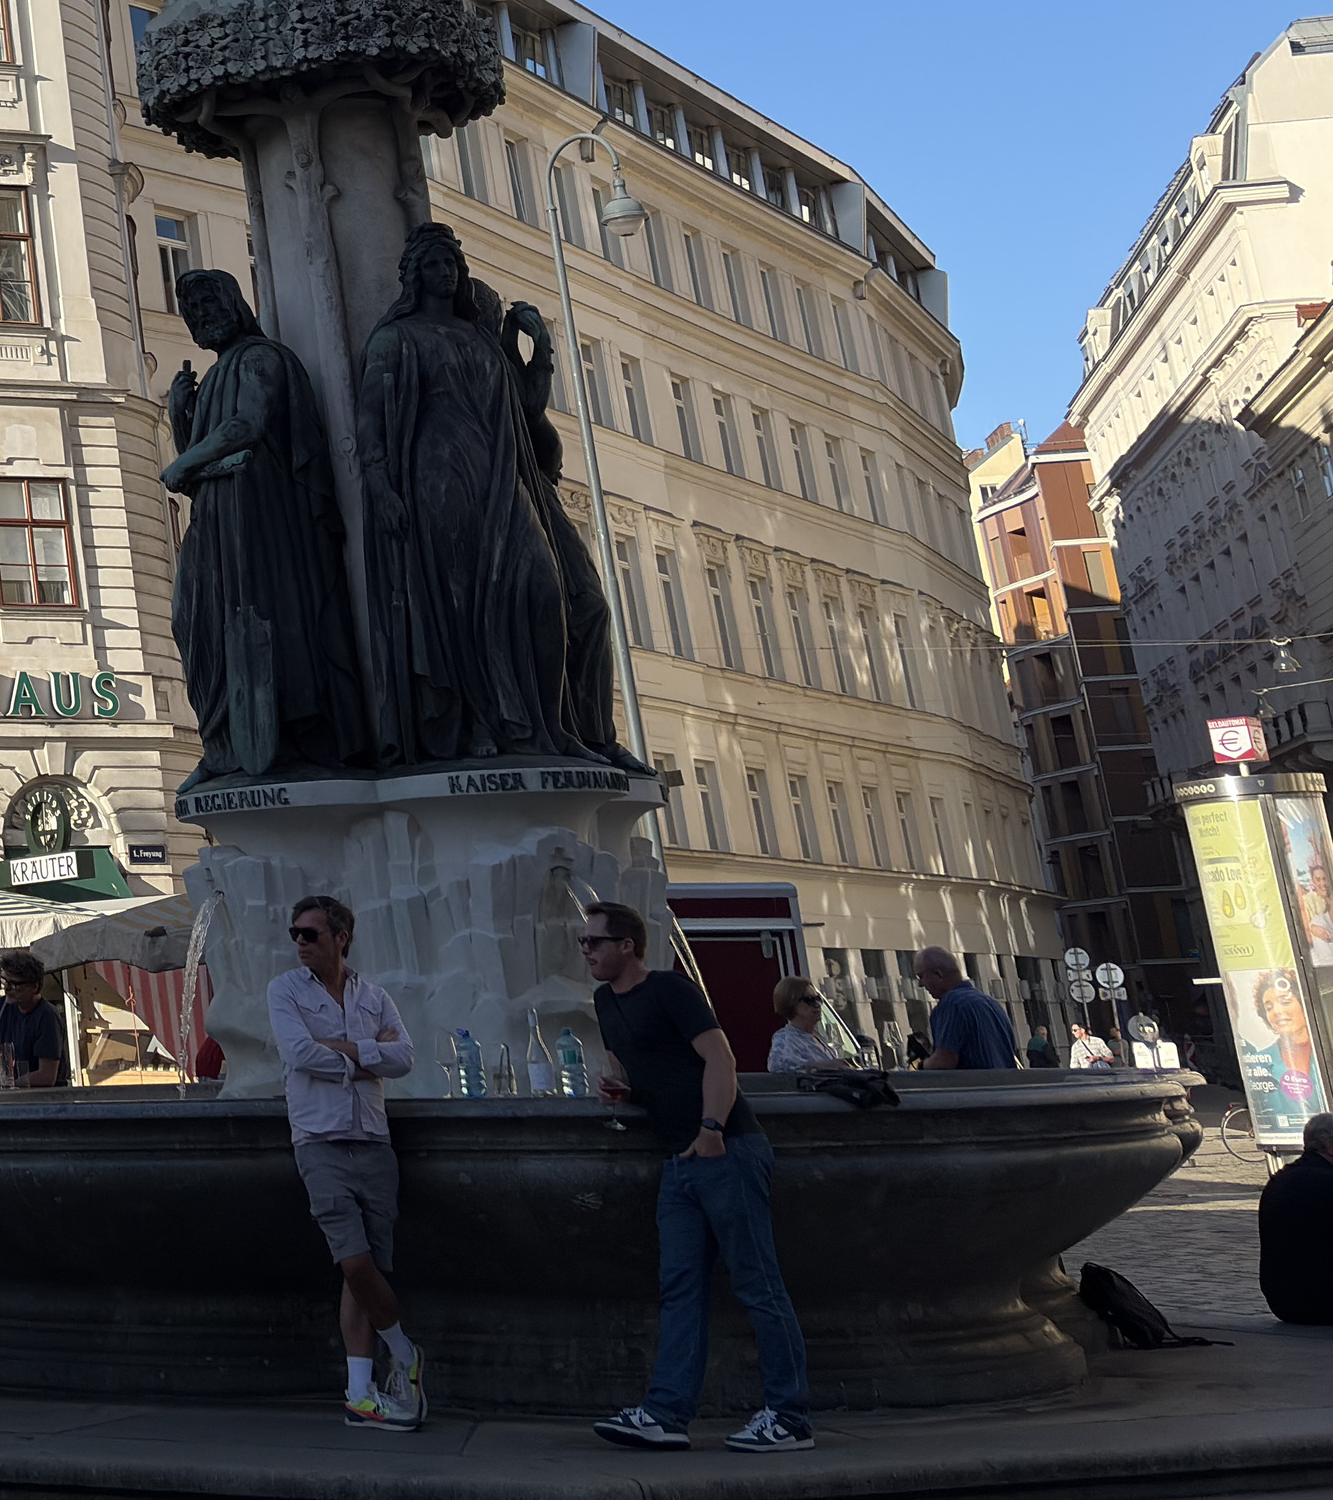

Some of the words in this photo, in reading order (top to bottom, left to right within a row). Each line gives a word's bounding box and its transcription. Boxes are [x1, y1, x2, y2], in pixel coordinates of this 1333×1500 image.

[1208, 718, 1246, 729] GELDAUTOMAT
[448, 772, 527, 794] KAISER
[25, 792, 41, 821] SEIT
[44, 791, 62, 817] 1795
[194, 786, 290, 813] REGIERUNG
[140, 848, 163, 859] Freyung
[12, 855, 76, 883] KRÄUTER
